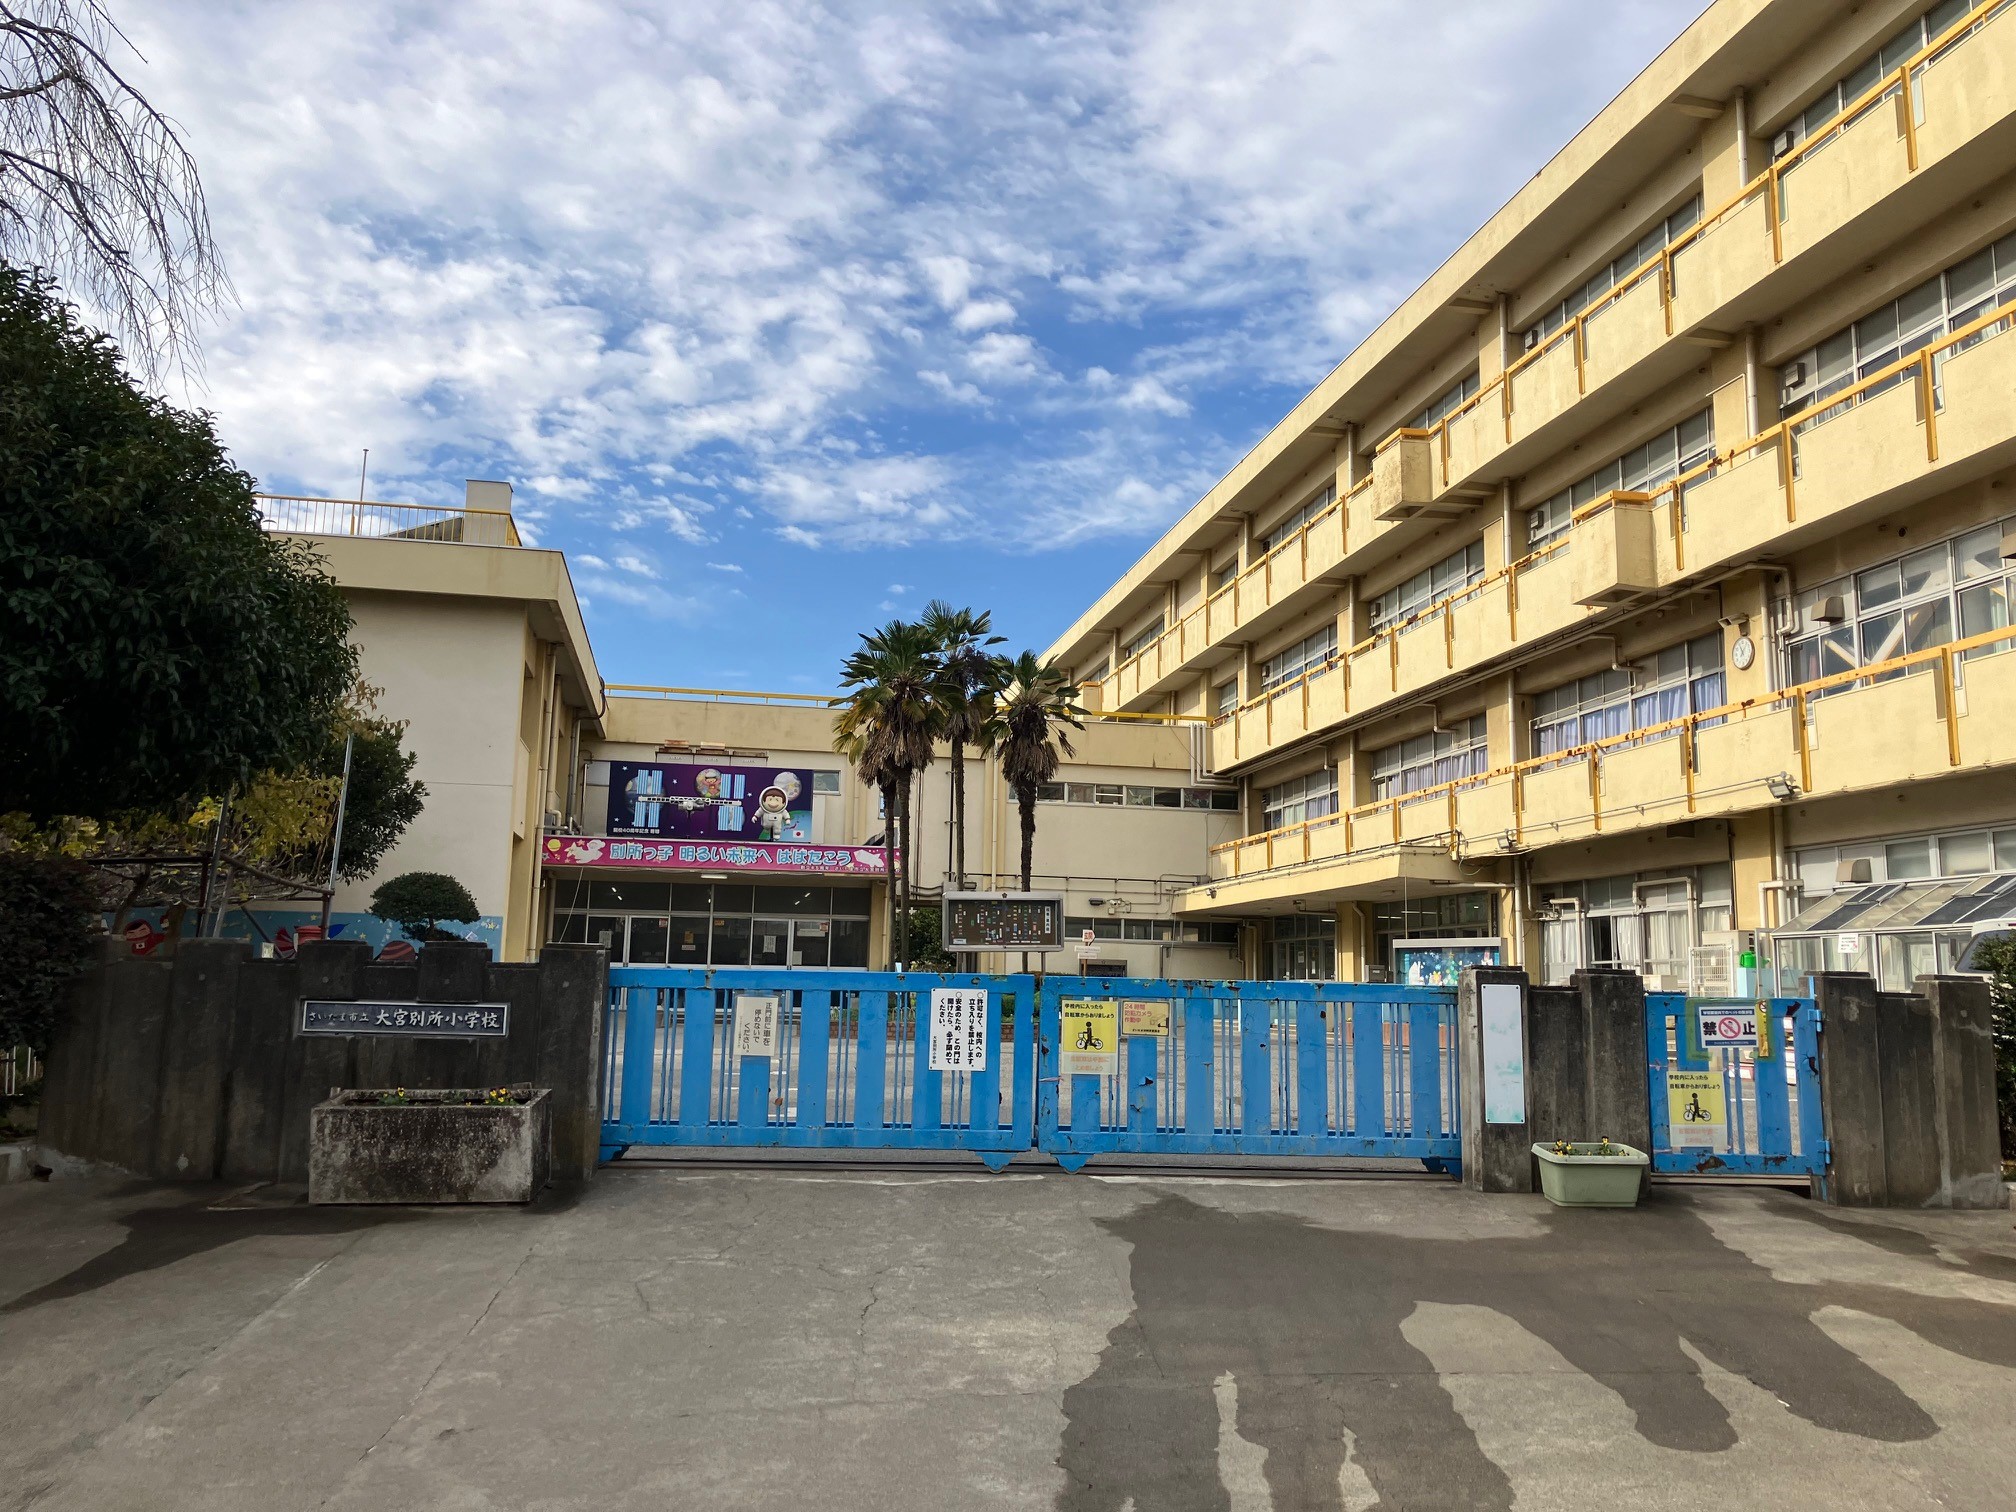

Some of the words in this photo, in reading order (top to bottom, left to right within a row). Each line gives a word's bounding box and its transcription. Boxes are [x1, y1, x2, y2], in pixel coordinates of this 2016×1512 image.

[610, 843, 673, 861] 別所っ子
[679, 846, 773, 864] 明るい未来へ
[777, 848, 852, 866] はばたこう
[374, 1009, 501, 1029] 大宮別所小学校
